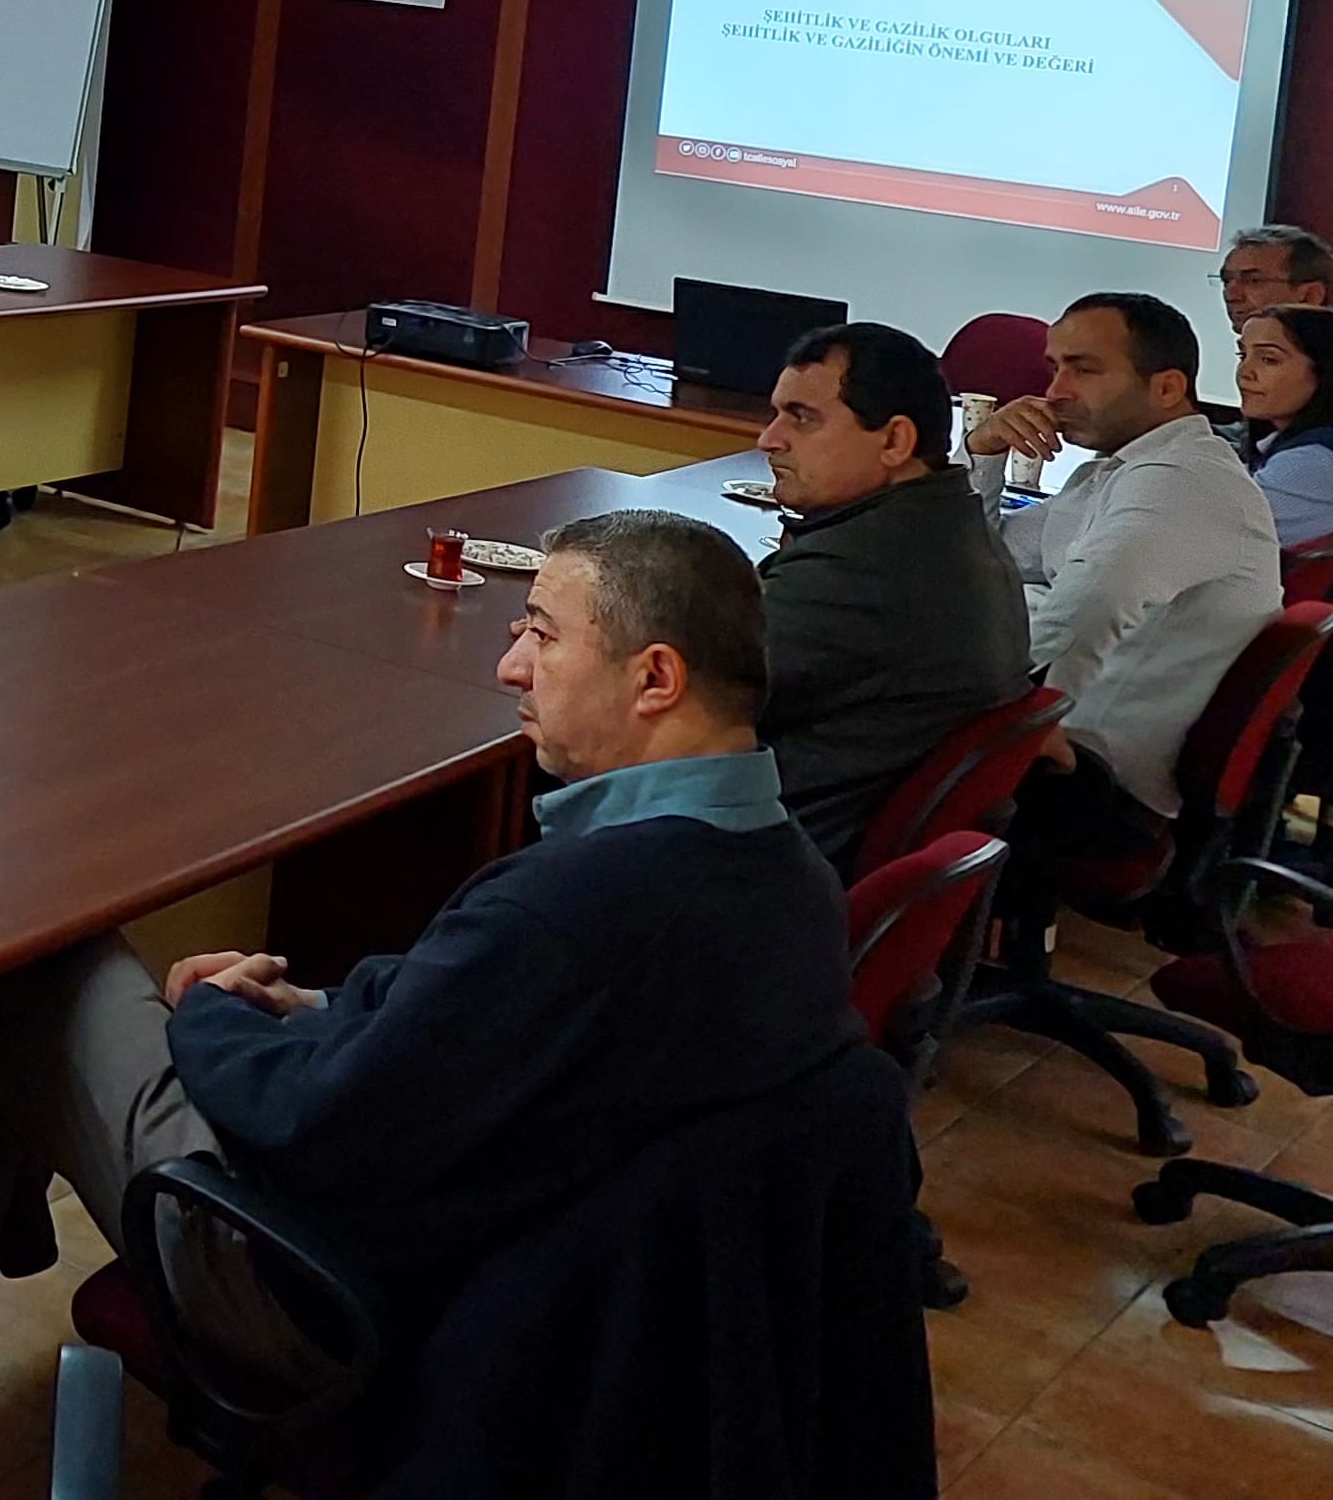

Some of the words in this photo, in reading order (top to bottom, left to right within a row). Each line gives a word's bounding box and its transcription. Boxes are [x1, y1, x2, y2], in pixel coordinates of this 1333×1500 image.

[721, 22, 801, 44] ŞEHİTLİK
[805, 31, 827, 47] VE
[832, 34, 925, 56] GAZİLİĞİN
[928, 43, 989, 64] ÖNEMİ
[994, 51, 1018, 67] VE
[1022, 55, 1094, 75] DEĞERİ
[763, 8, 844, 30] ŞEHİTLİK
[848, 17, 871, 32] VE
[875, 19, 951, 41] GAZİLİK
[954, 27, 1052, 50] OLGULARI
[1096, 202, 1181, 221] www.aile.gov.tr
